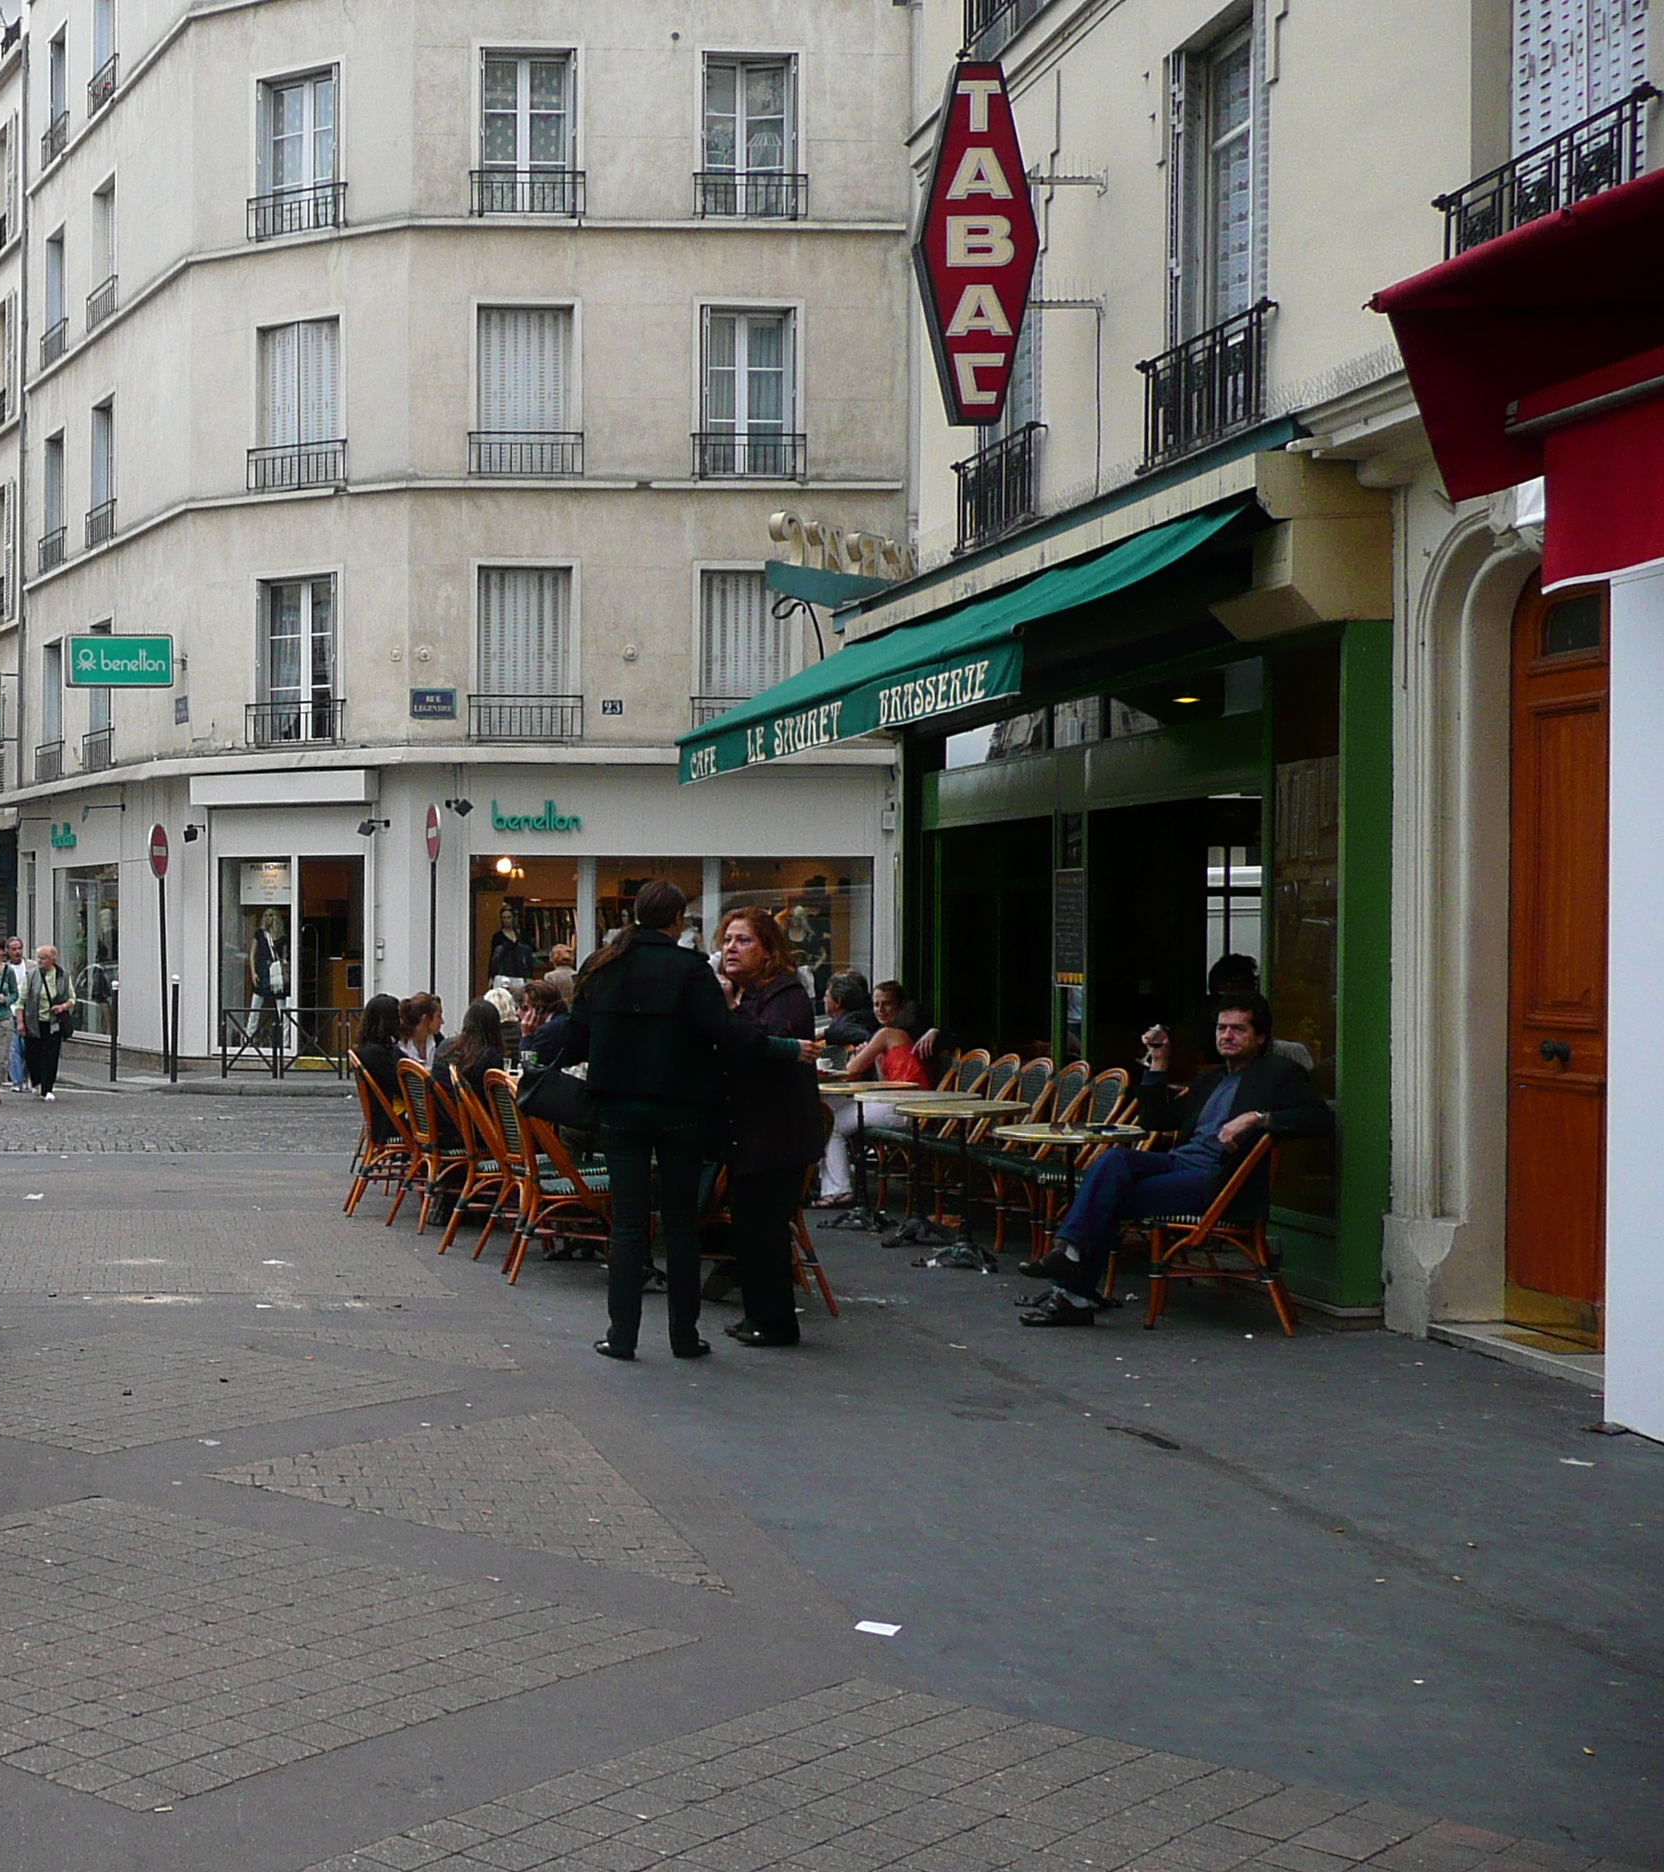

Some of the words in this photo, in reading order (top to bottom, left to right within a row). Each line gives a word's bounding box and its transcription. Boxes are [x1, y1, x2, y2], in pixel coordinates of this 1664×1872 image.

[945, 80, 1015, 404] TABAC
[100, 648, 166, 672] benetton
[413, 704, 453, 713] LEGENDRE
[425, 695, 442, 704] RUE
[604, 701, 621, 714] 23
[689, 745, 717, 779] CAFE
[746, 725, 765, 764] LE
[773, 701, 842, 756] SAURET
[878, 660, 990, 725] BRASSERIE
[491, 799, 583, 831] benetton
